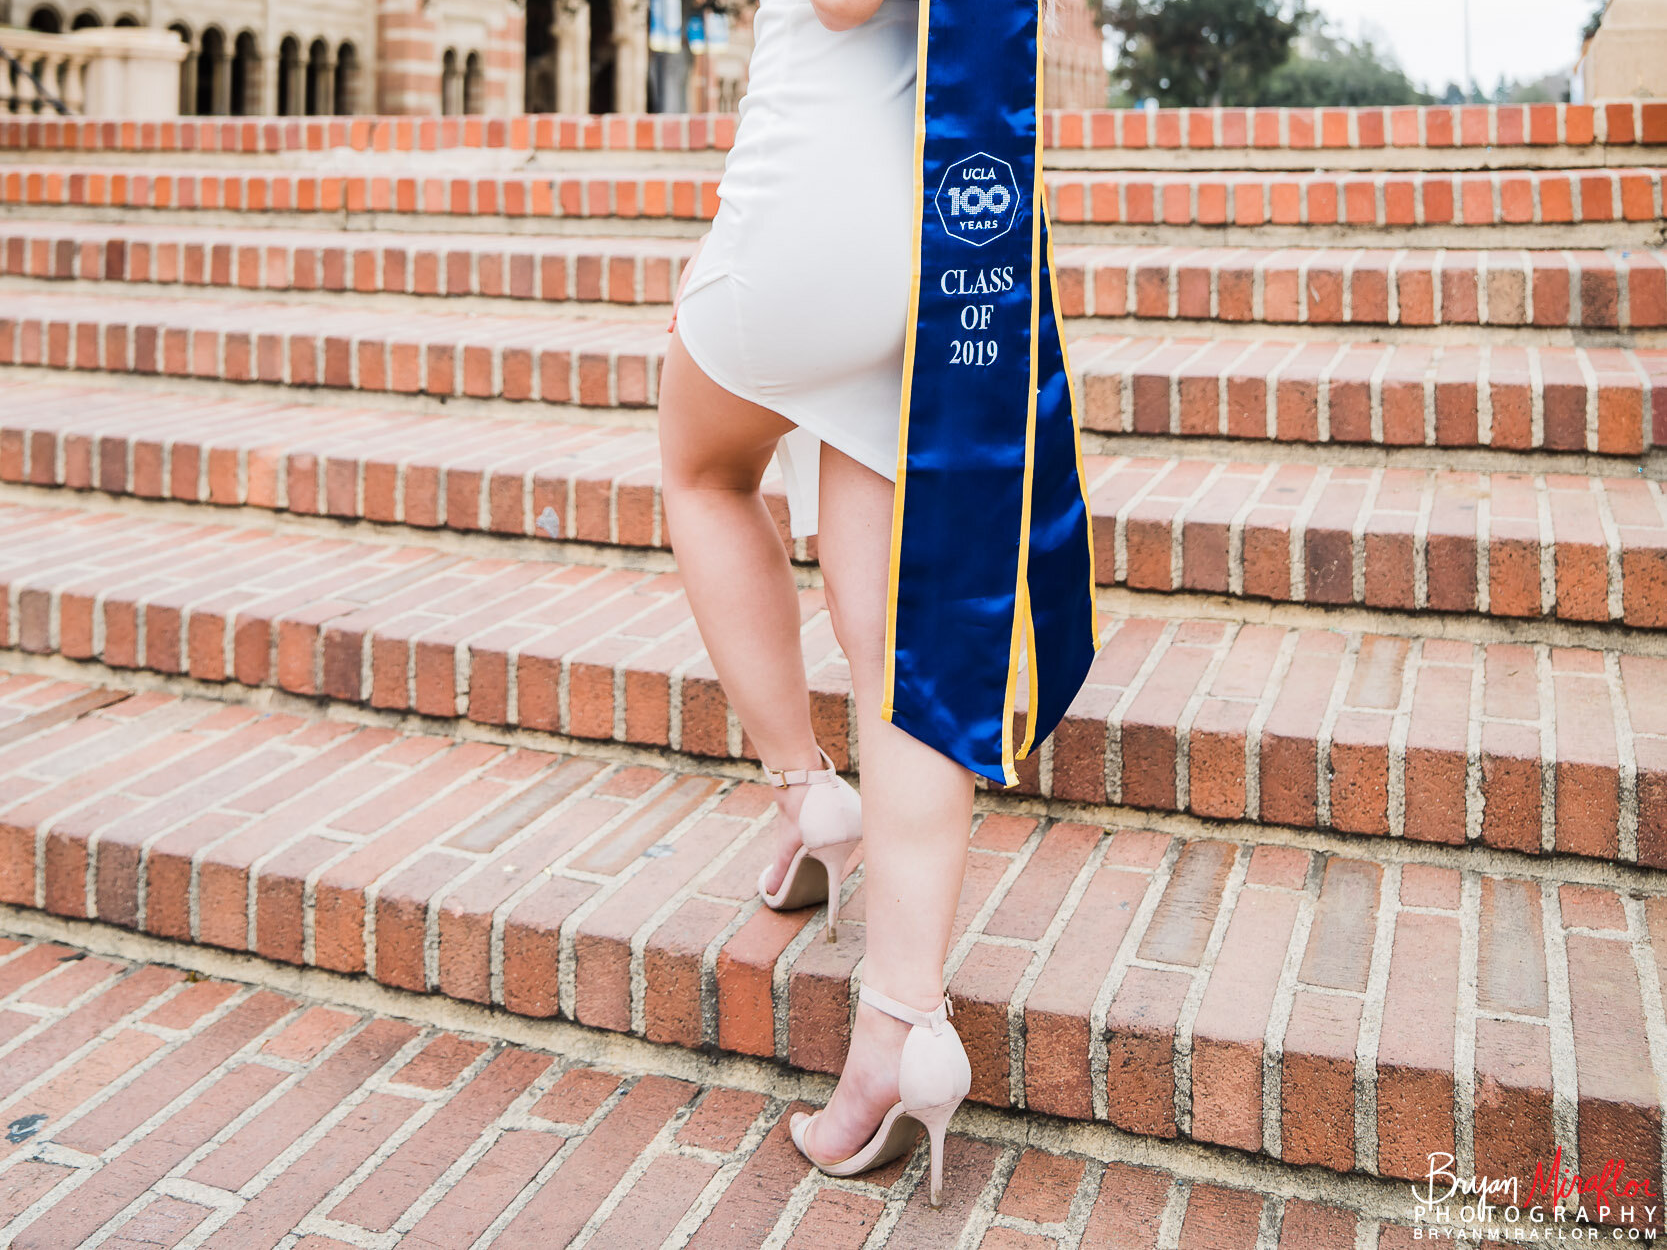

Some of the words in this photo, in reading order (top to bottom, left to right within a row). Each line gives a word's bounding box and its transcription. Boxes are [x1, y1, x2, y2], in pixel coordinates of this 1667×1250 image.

[963, 167, 996, 180] UCLA
[948, 184, 1011, 215] 100
[960, 220, 998, 230] YEARS
[940, 266, 1014, 295] CLASS
[960, 305, 994, 330] OF
[949, 340, 998, 366] 2019
